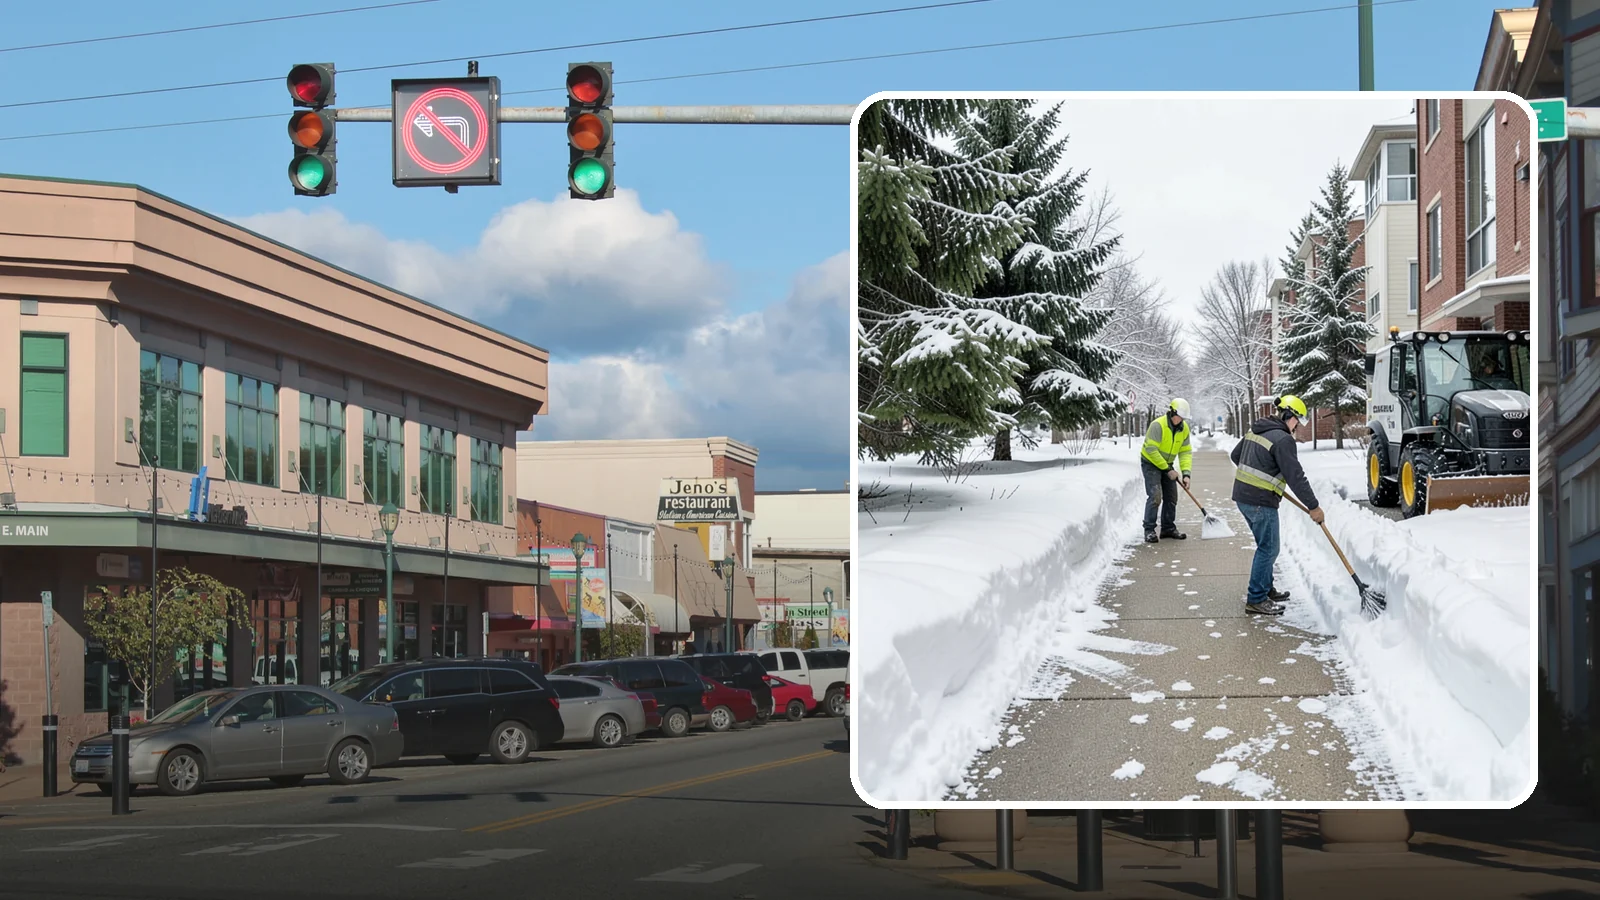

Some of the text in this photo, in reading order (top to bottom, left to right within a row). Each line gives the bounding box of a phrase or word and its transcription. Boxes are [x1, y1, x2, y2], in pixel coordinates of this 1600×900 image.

[669, 480, 728, 495] Jeno's
[665, 496, 731, 509] restaurant
[659, 509, 681, 519] Italian
[686, 509, 714, 519] American
[715, 509, 737, 519] Cuisine
[2, 525, 49, 536] E. MAIN
[797, 607, 828, 617] Street
[790, 619, 824, 627] lass
